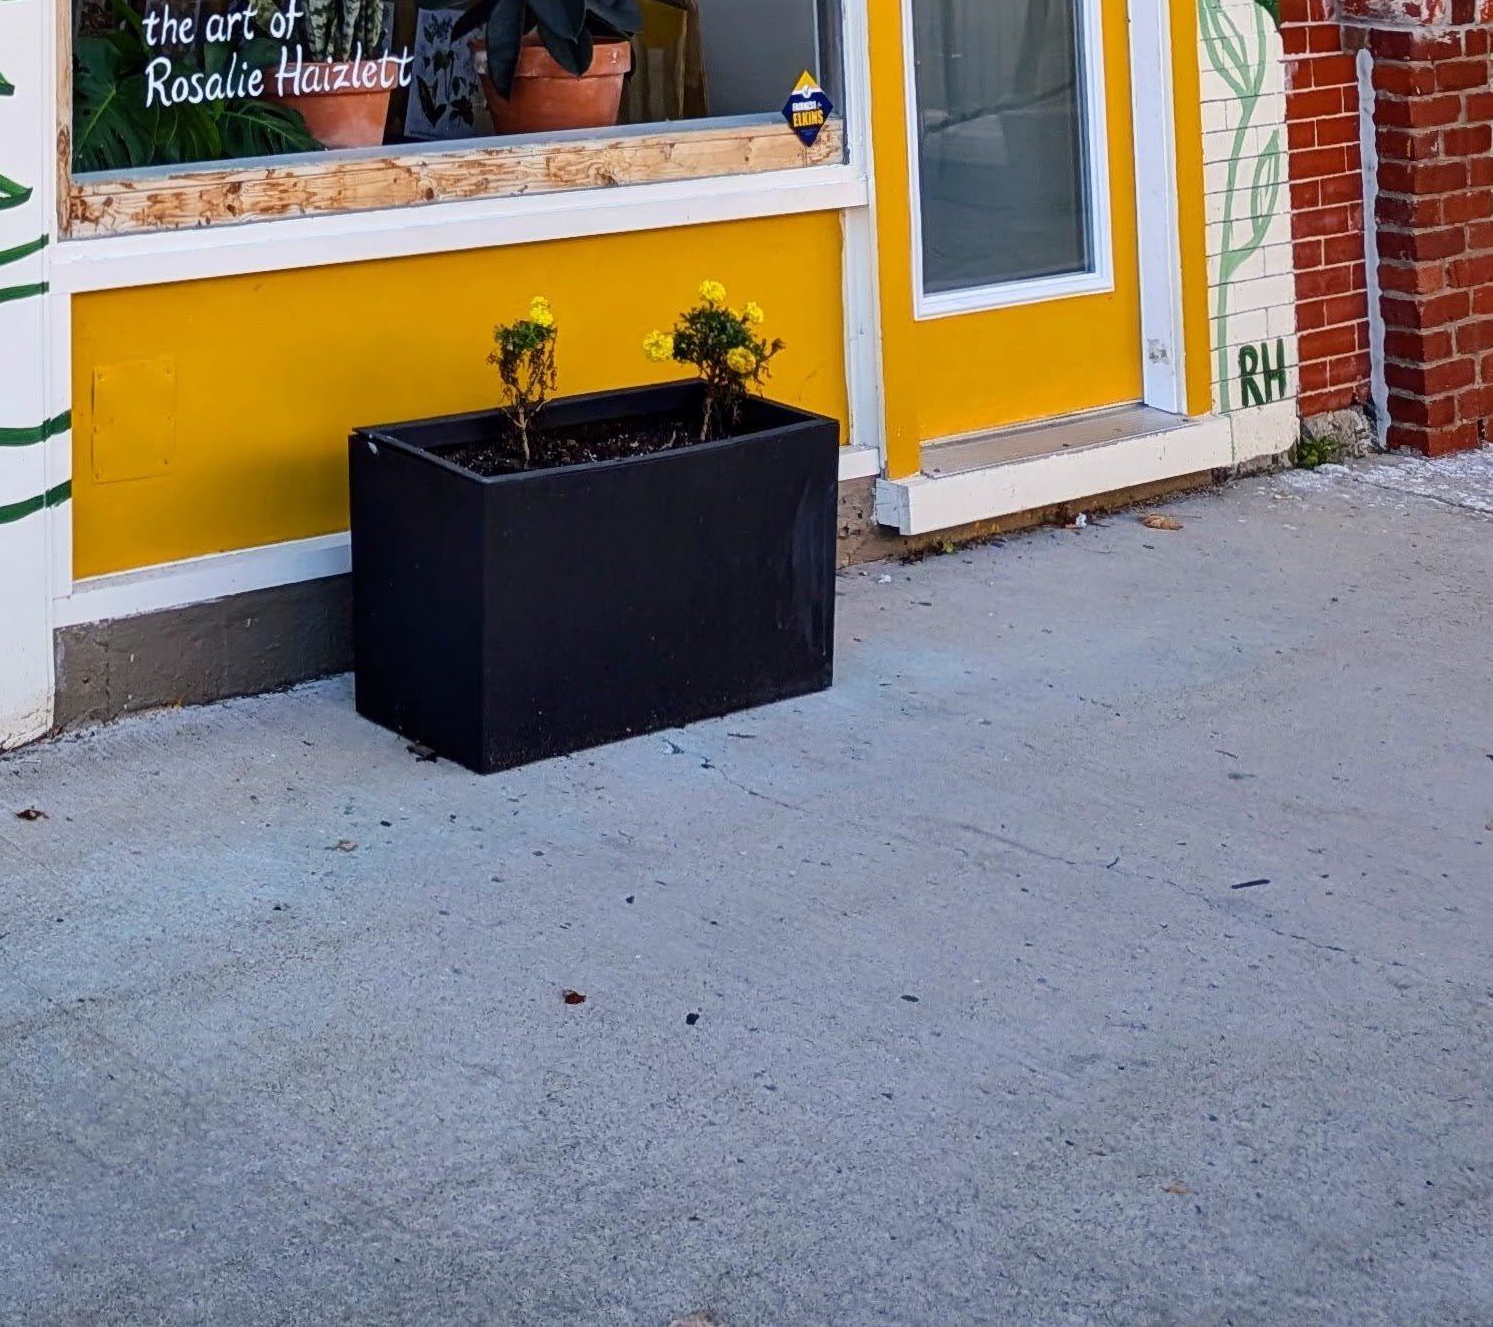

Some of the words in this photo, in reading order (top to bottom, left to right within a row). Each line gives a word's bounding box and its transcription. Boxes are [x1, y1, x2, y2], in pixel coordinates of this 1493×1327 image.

[142, 3, 194, 46] the
[206, 2, 259, 41] art
[145, 51, 265, 108] Rosalie
[275, 42, 415, 97] Haizlett
[793, 109, 824, 128] ELKINS
[1238, 338, 1287, 408] RH
